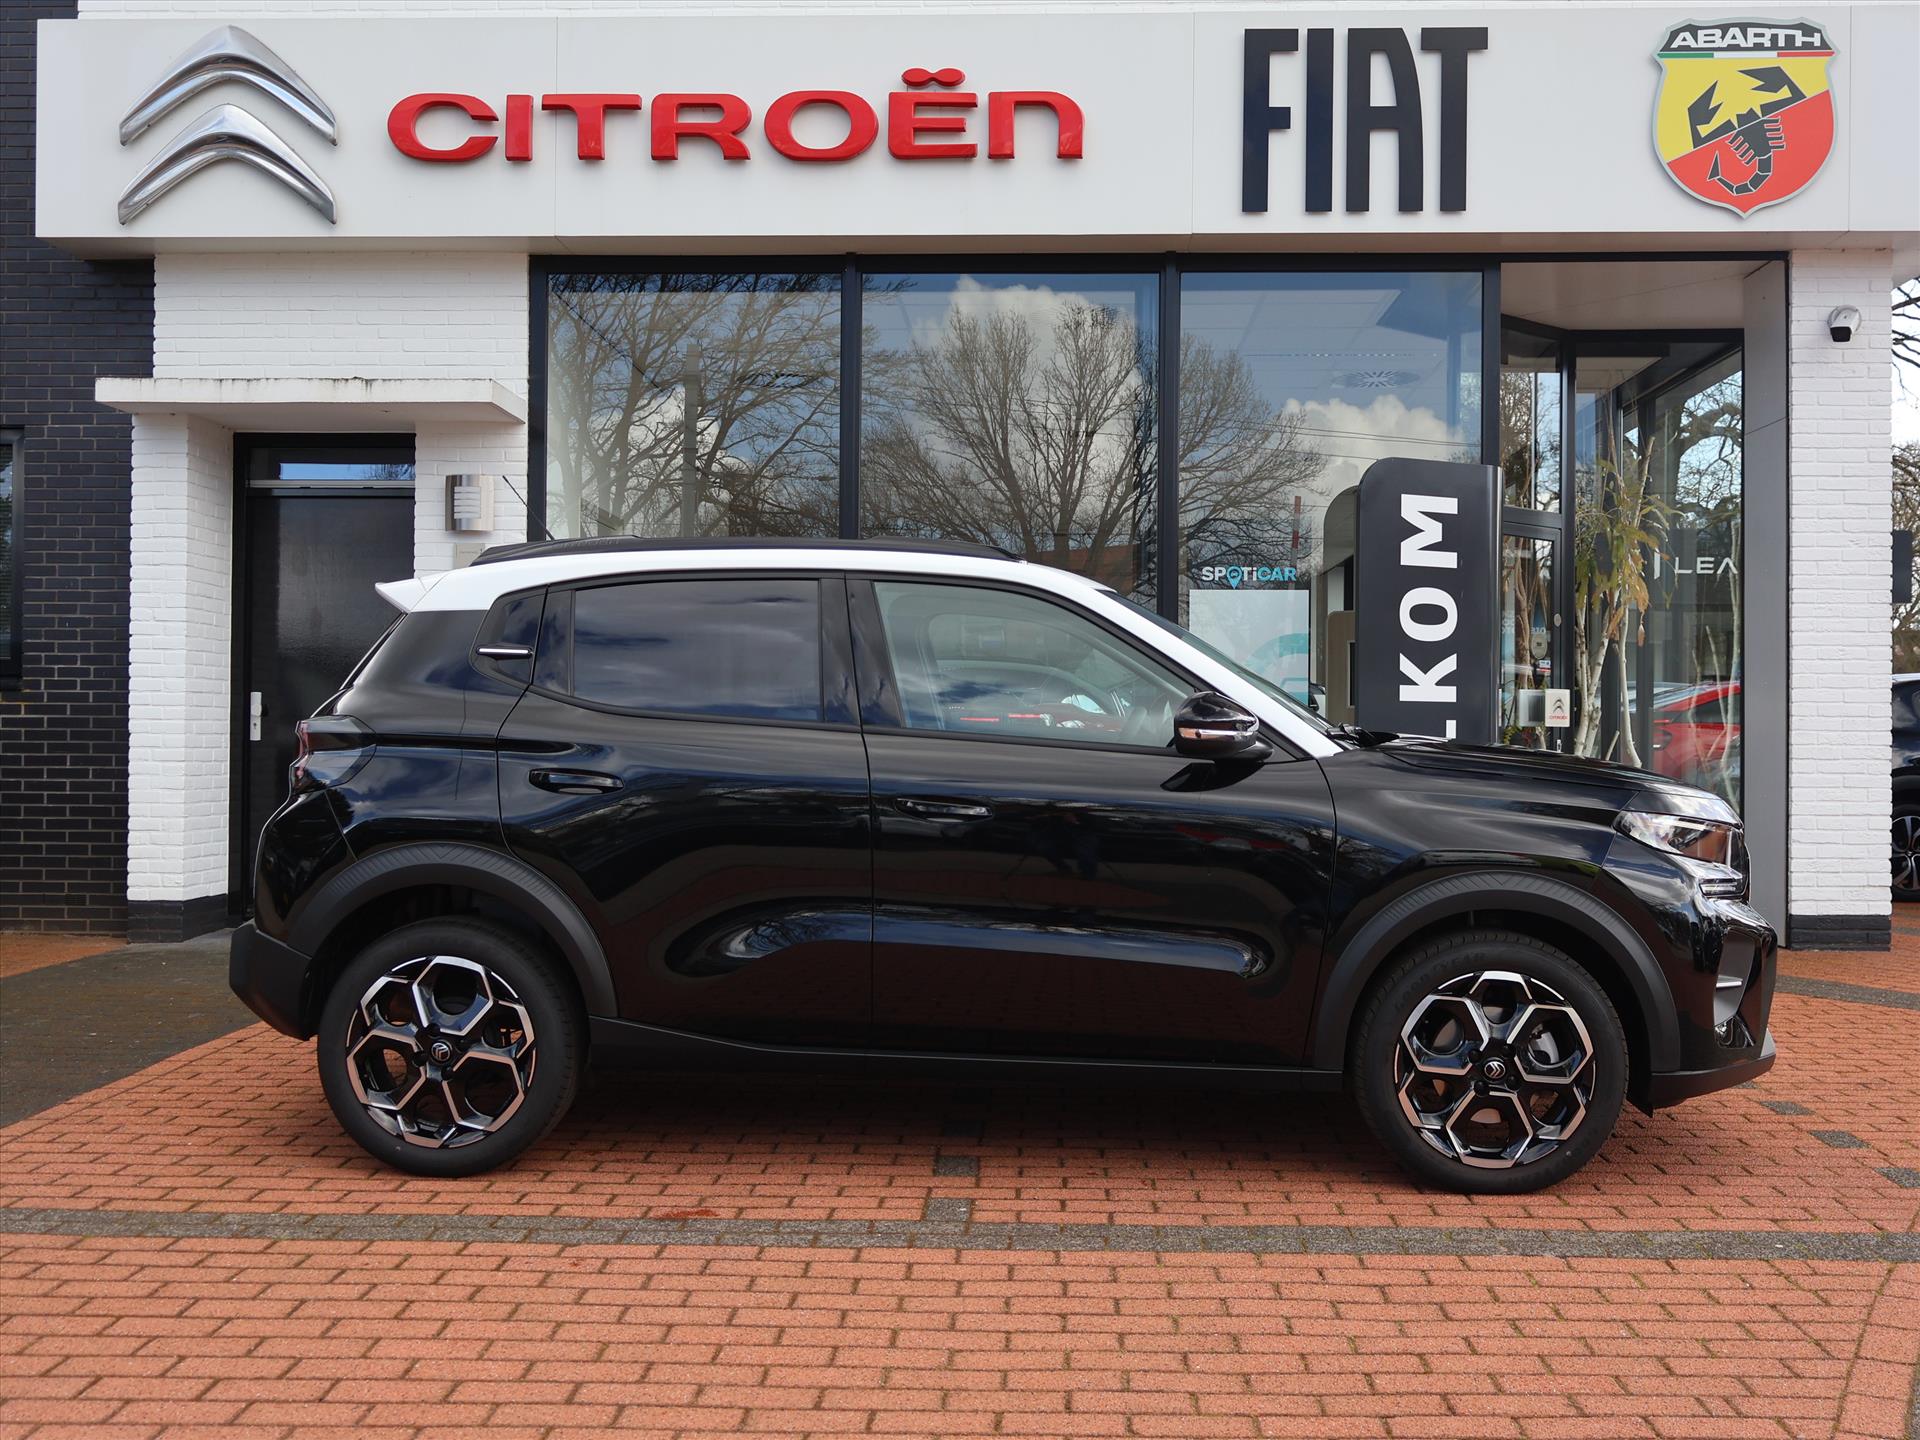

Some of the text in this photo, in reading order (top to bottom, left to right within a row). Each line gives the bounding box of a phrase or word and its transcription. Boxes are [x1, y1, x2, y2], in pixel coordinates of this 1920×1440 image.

[1241, 26, 1489, 213] FIAT
[1669, 26, 1822, 49] ABARTH
[1399, 493, 1458, 739] KOM
